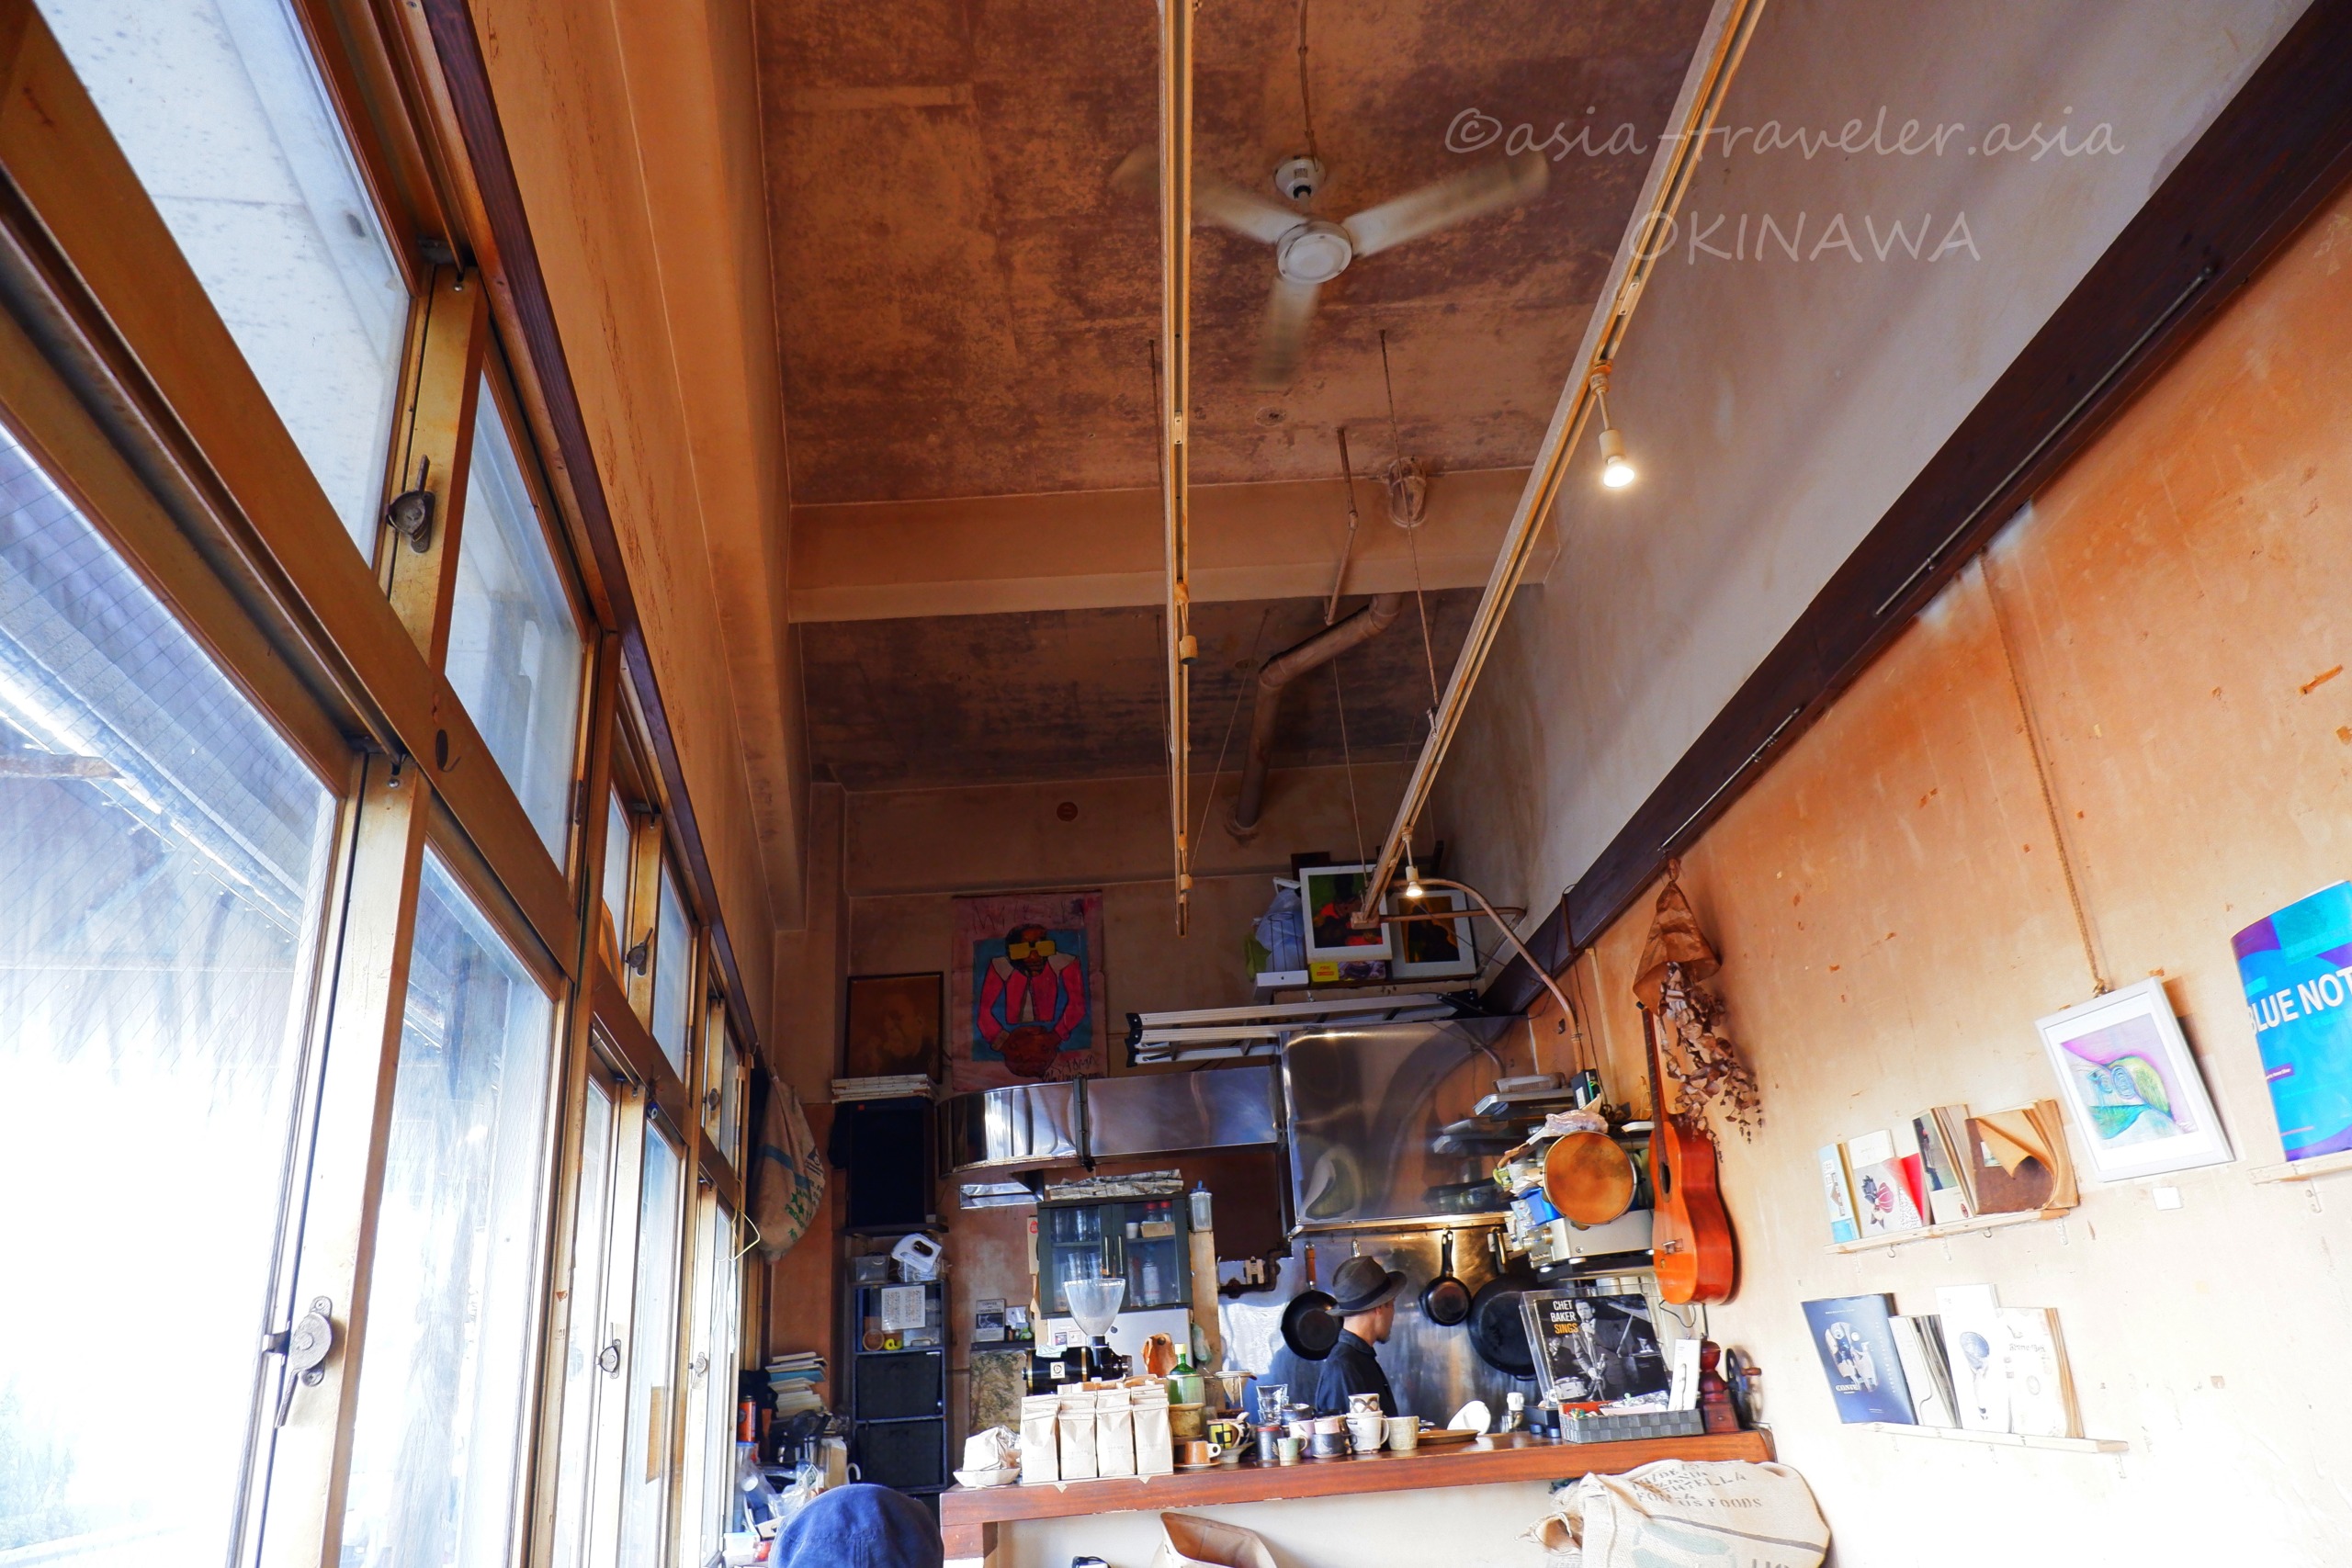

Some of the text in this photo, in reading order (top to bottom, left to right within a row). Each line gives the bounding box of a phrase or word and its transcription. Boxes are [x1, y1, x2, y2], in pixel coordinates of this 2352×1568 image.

[2247, 987, 2300, 1034] BLUE
[1553, 1299, 1573, 1311] CHET
[1550, 1312, 1577, 1323] BAKER
[1554, 1323, 1579, 1335] SINGS
